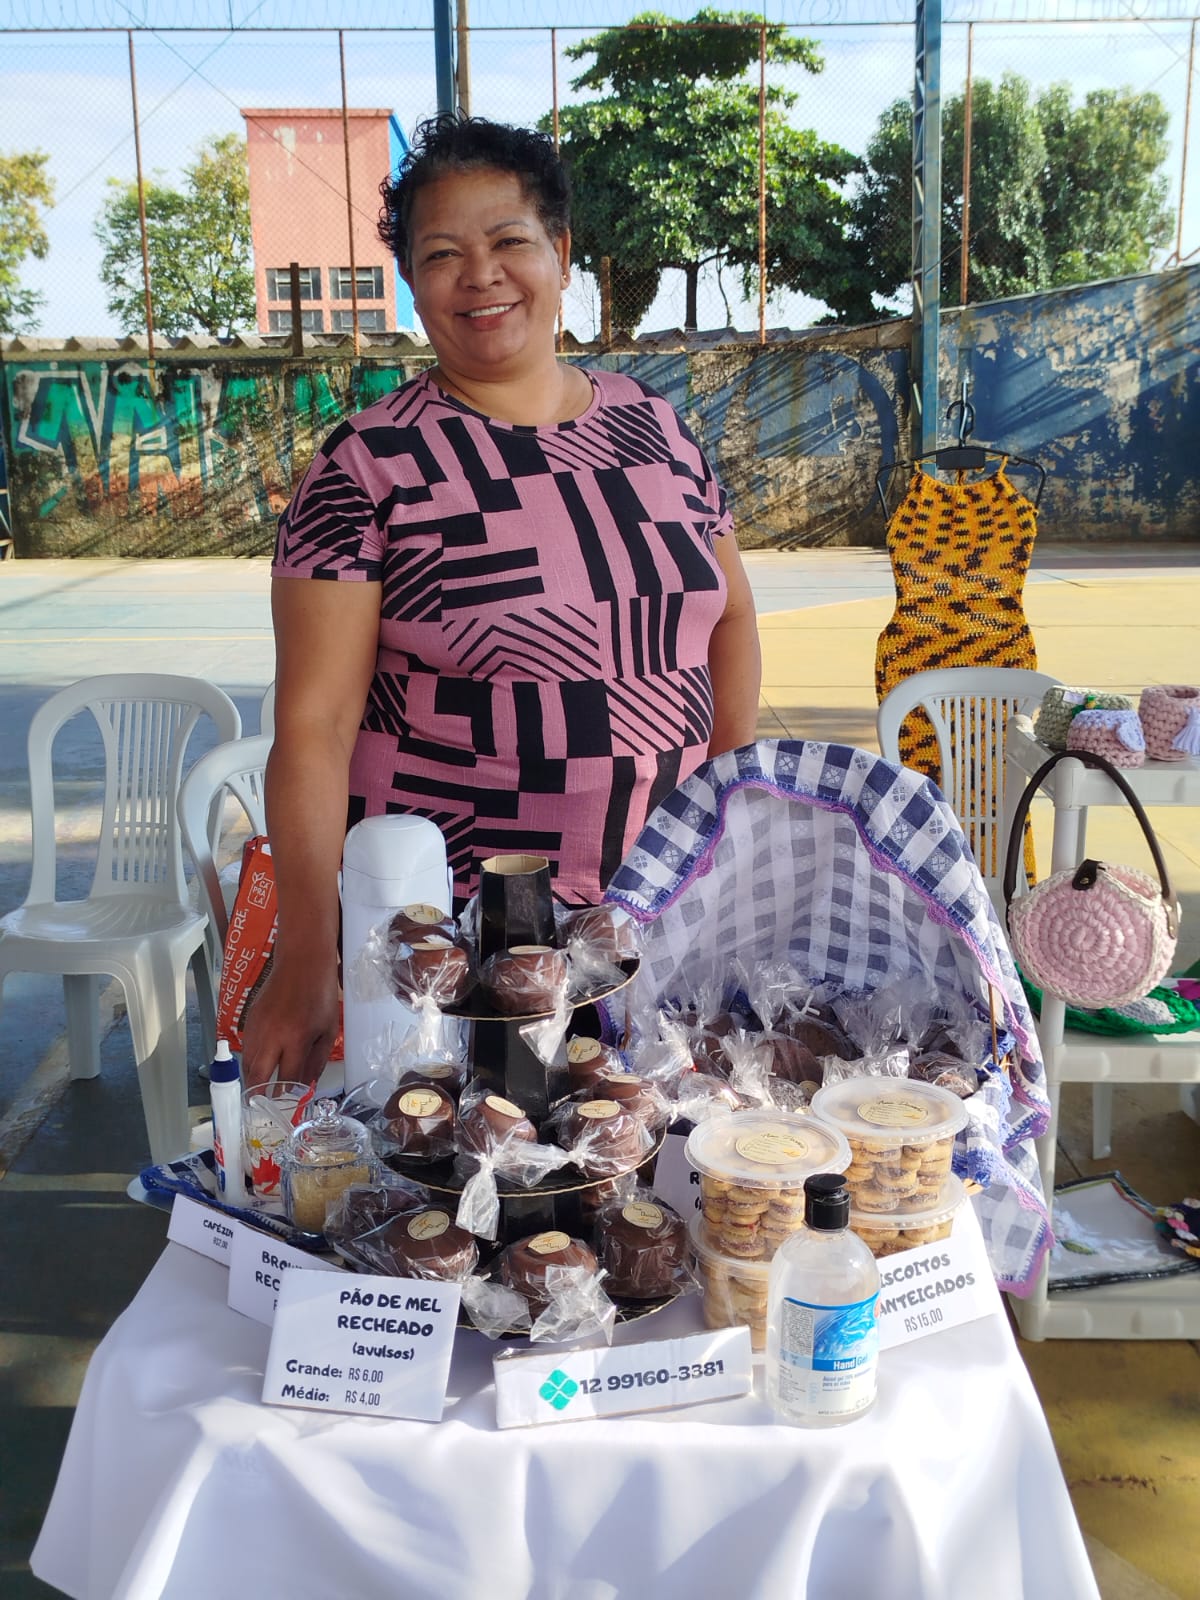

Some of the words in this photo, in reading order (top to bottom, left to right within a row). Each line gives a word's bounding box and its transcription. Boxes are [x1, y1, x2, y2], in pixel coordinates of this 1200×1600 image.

[203, 1219, 233, 1239] CAFÉZIN
[880, 1253, 951, 1289] ISCOITOS
[340, 1288, 373, 1307] PÃO
[378, 1293, 401, 1309] DE
[405, 1297, 442, 1313] MEL
[879, 1272, 976, 1318] ANTEIGADOS
[337, 1315, 434, 1337] RECHEADO
[352, 1342, 415, 1361] (avulsos)
[286, 1359, 343, 1379] Grande:
[833, 1358, 856, 1371] Hand
[580, 1378, 602, 1394] 12
[607, 1359, 725, 1391] 99160-3381
[281, 1384, 329, 1403] Médio:
